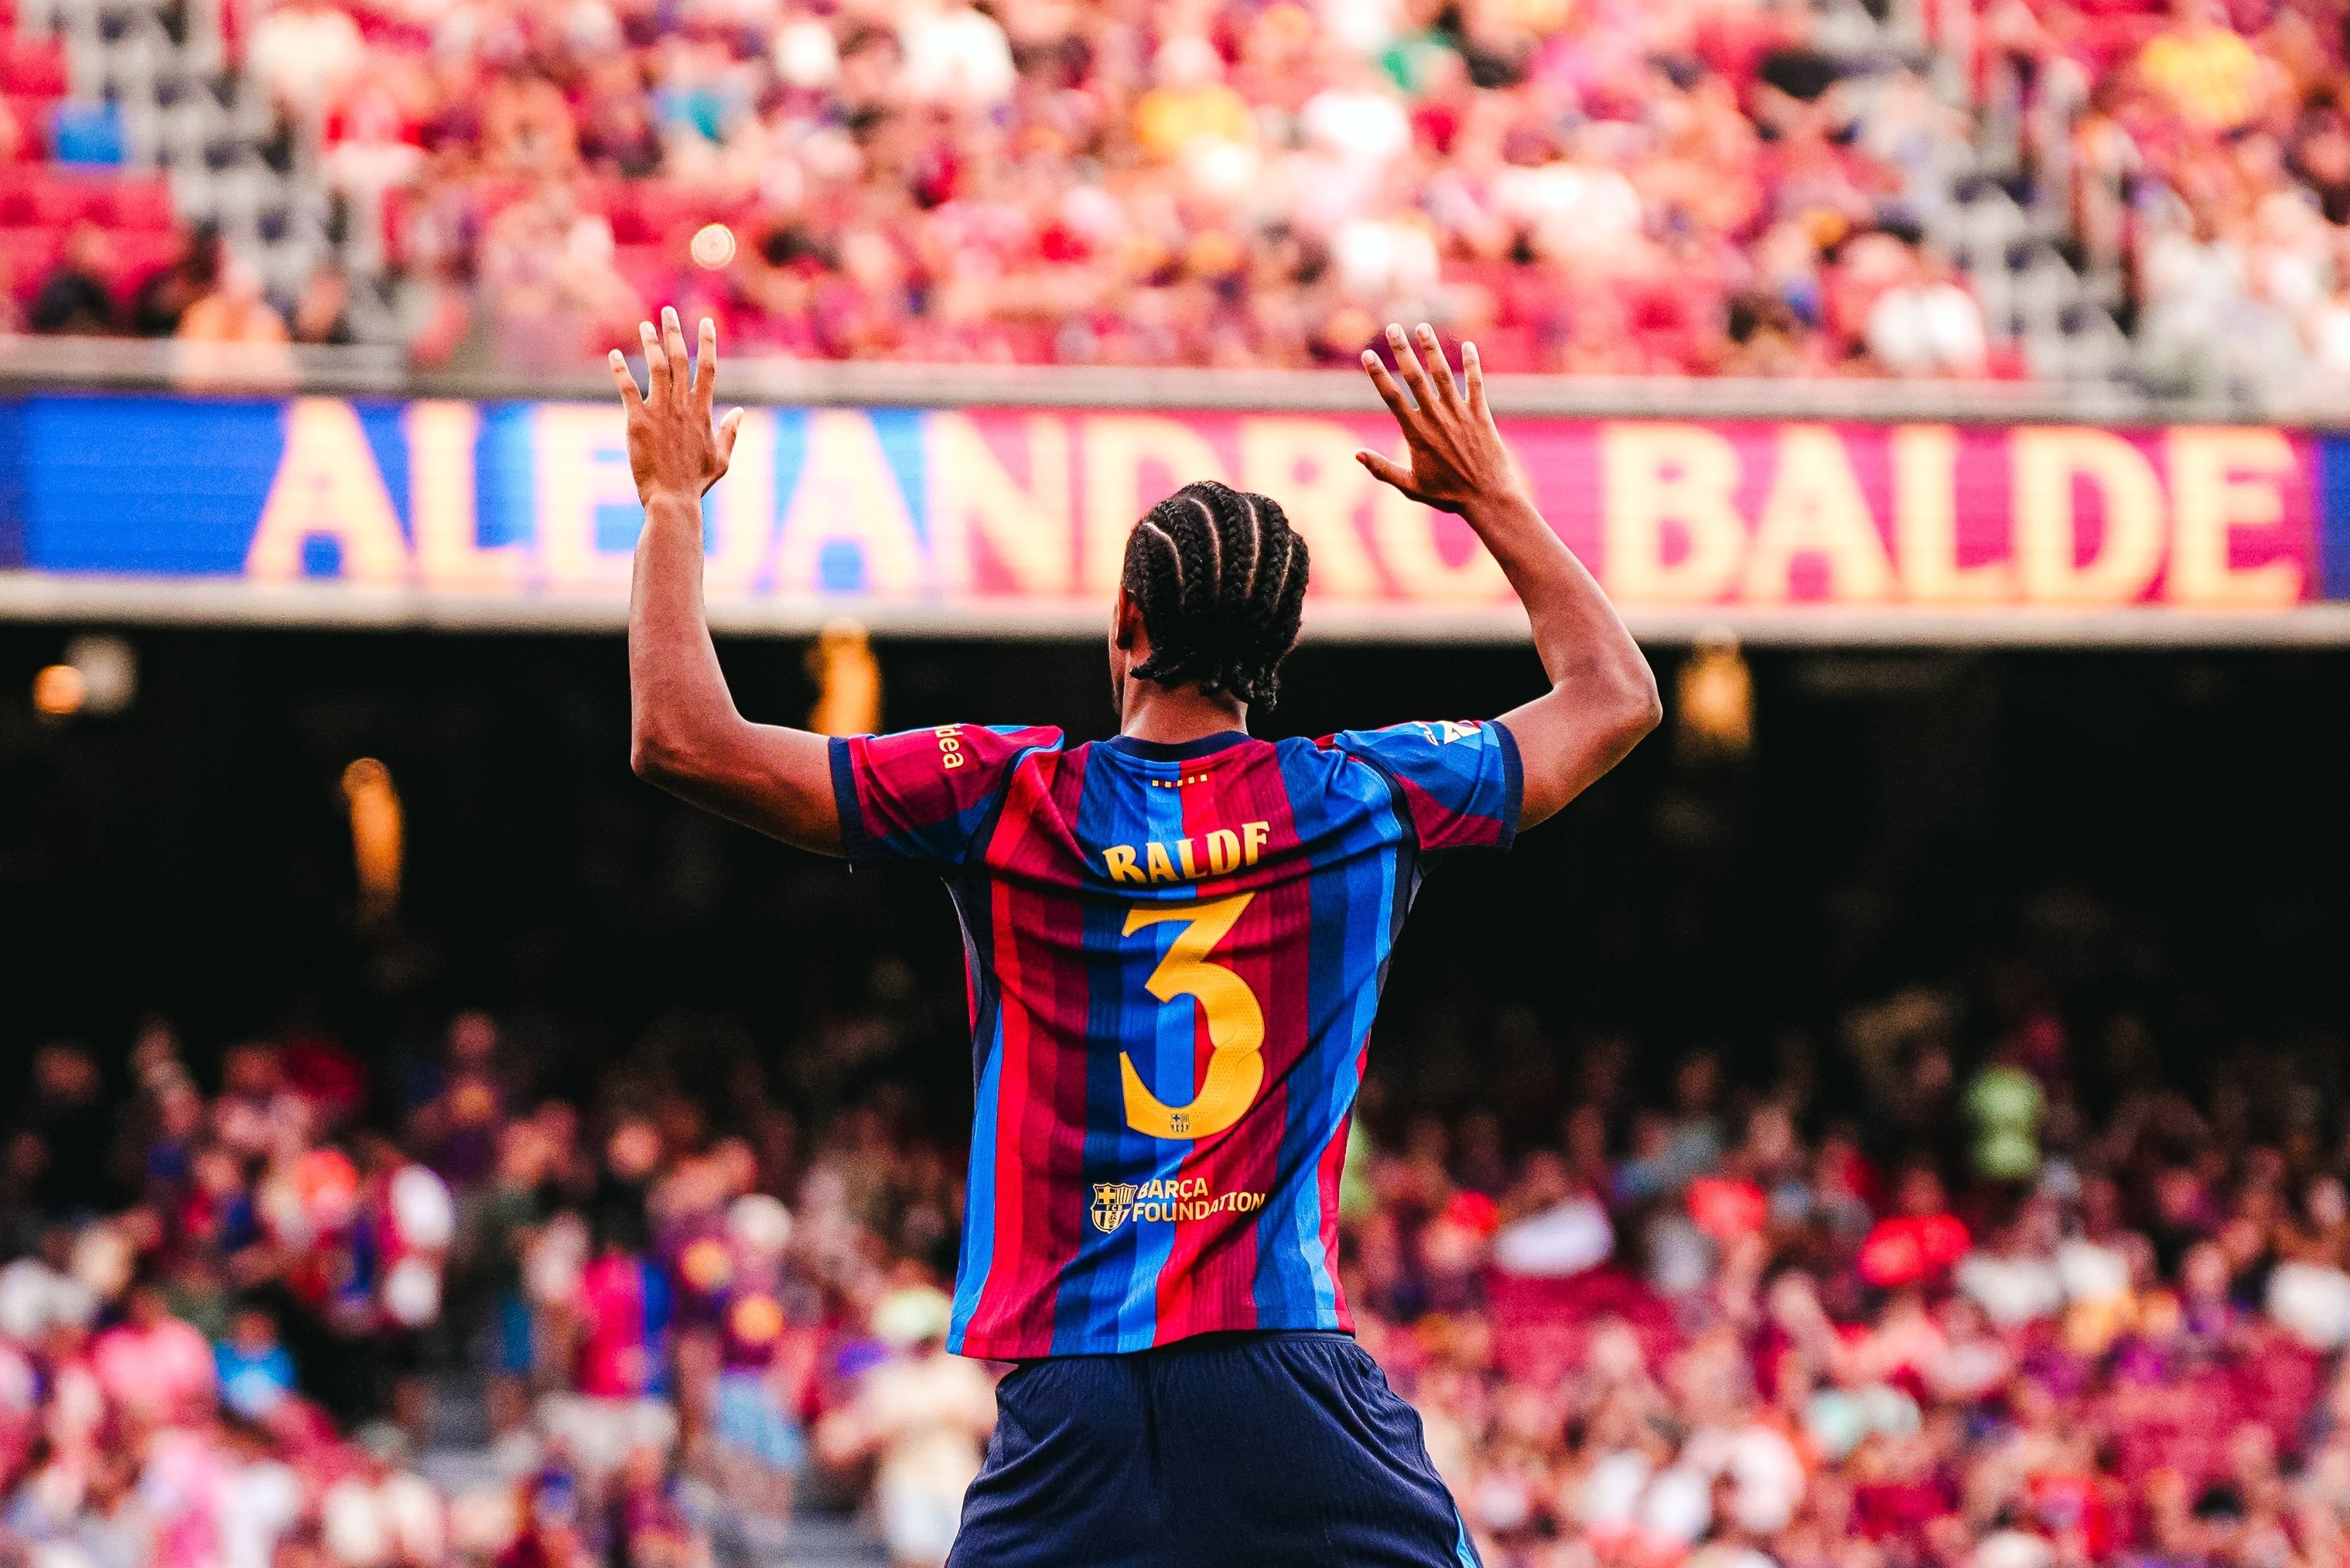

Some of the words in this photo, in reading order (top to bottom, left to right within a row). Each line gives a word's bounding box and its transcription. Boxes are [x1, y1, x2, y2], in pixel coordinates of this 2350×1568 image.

[1600, 422, 2308, 608] BALDE
[1119, 891, 1265, 1140] 3
[1132, 1191, 1266, 1222] FOUNDATION
[1137, 1177, 1208, 1201] BARÇA
